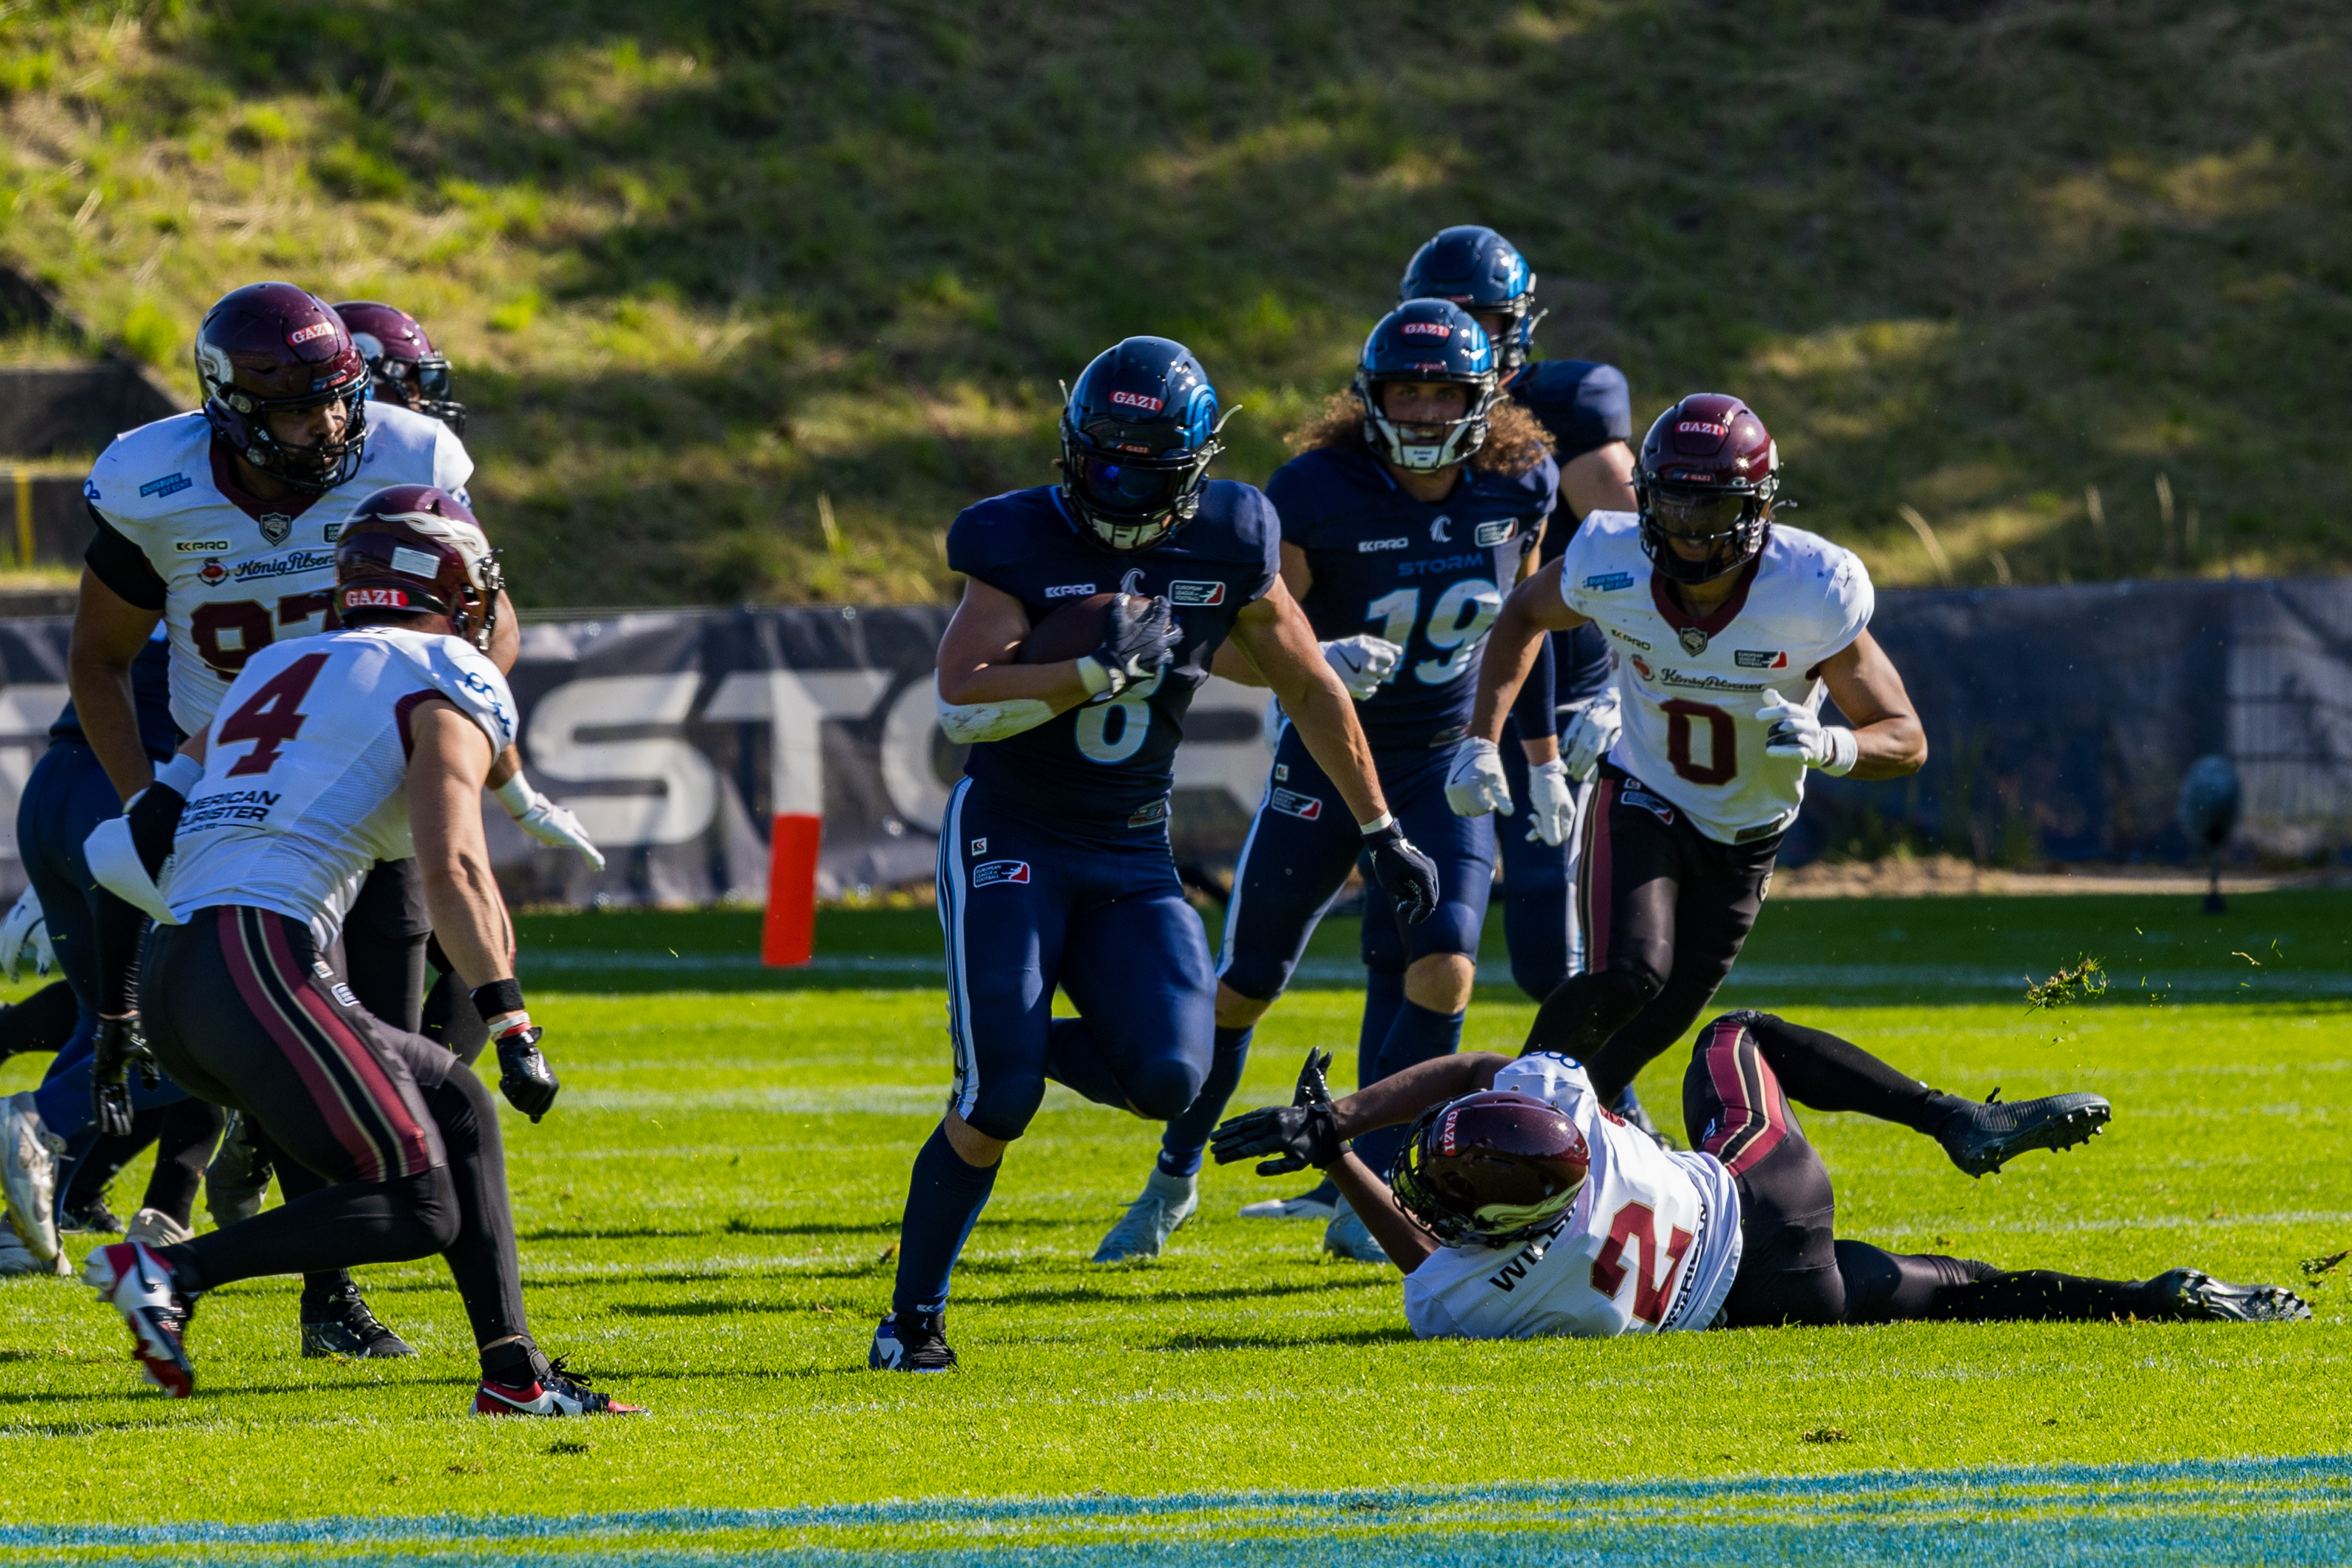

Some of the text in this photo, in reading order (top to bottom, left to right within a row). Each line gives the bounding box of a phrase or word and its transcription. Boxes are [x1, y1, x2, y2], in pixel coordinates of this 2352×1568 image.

[291, 322, 334, 343] GAZ
[1398, 552, 1484, 576] STORM
[1364, 578, 1504, 687] 19
[217, 652, 331, 778] 4
[1657, 697, 1739, 787] 0
[184, 790, 282, 813] MERICAN
[1589, 1201, 1694, 1327] 2
